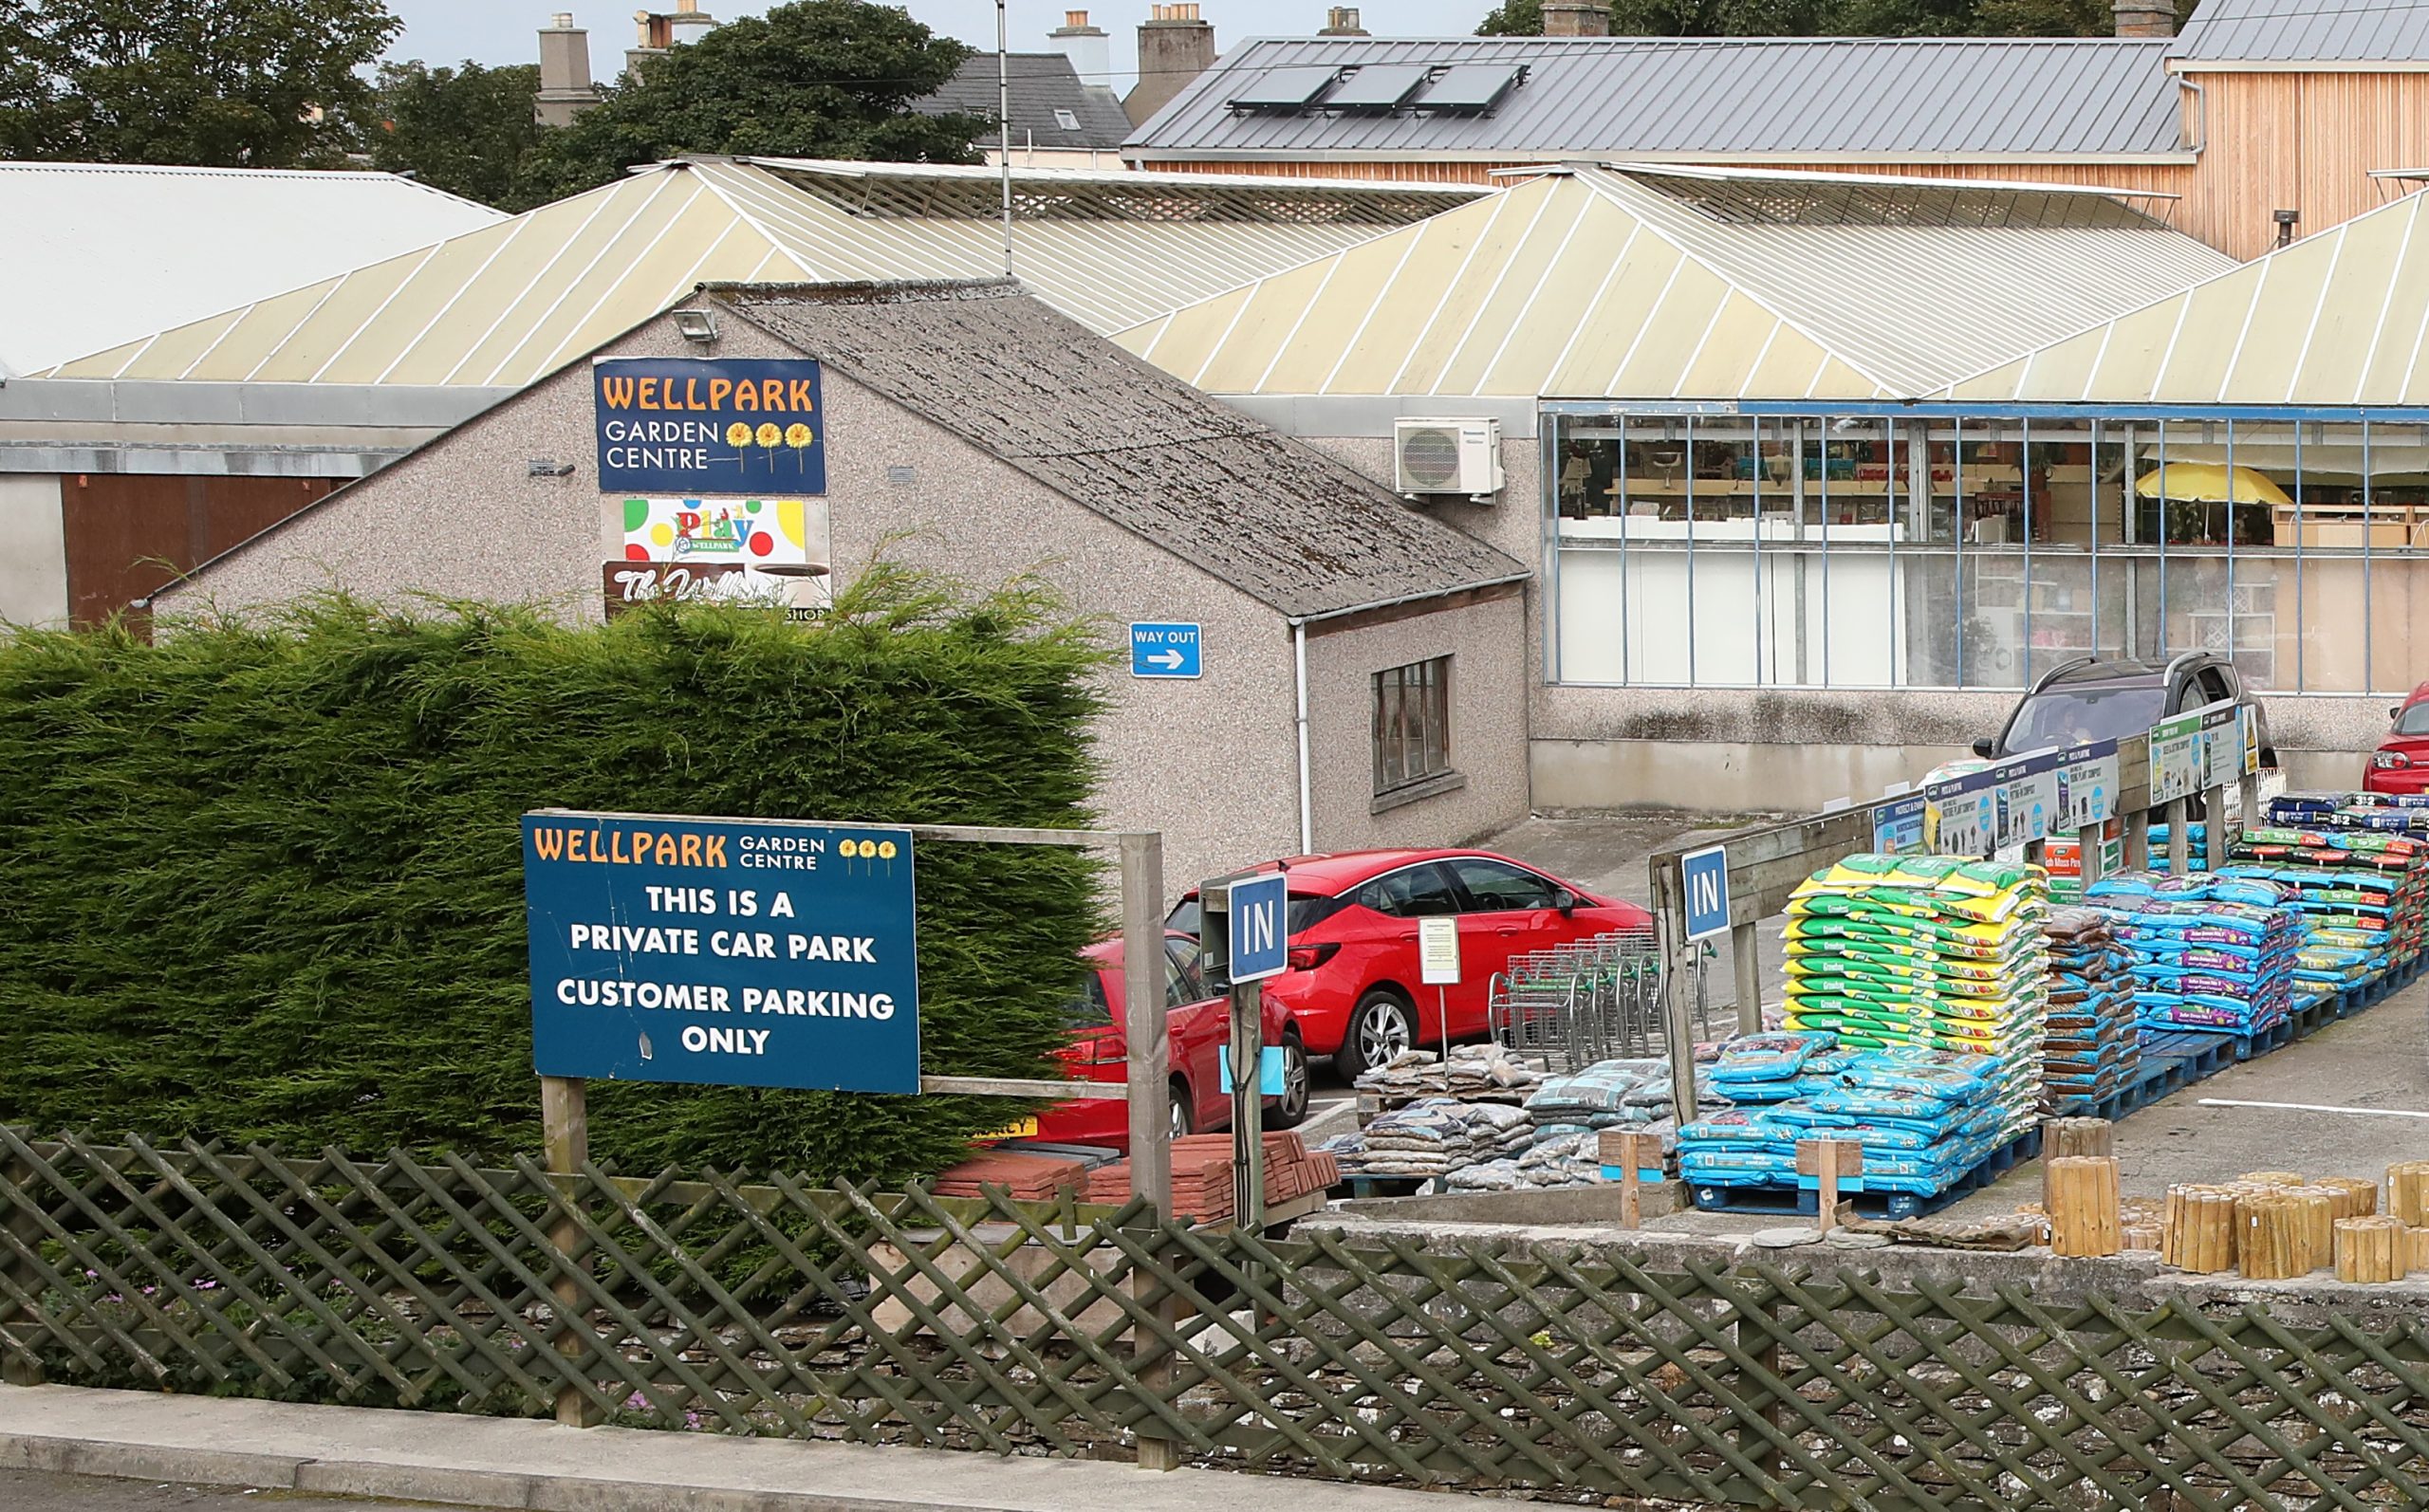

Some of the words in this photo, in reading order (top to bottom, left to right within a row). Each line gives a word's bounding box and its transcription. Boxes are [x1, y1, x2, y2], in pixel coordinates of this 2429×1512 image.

[603, 378, 812, 411] WELLPARK
[605, 421, 718, 443] GARDEN
[606, 448, 708, 469] CENTRE
[787, 610, 825, 620] SHOP
[1135, 632, 1163, 643] WAY
[1168, 632, 1196, 643] OUT
[534, 828, 728, 868] WELLPARK
[740, 837, 825, 853] GARDEN
[740, 853, 817, 871] CENTRE
[645, 886, 716, 914] THIS
[729, 890, 757, 917] IS
[770, 892, 795, 918] A
[1693, 869, 1719, 917] IN
[1244, 900, 1273, 955] IN
[571, 924, 698, 955] PRIVATE
[711, 931, 776, 959] CAR
[788, 934, 876, 964] PARK
[556, 979, 731, 1012] CUSTOMER
[743, 987, 895, 1021] PARKING
[681, 1025, 770, 1055] ONLY
